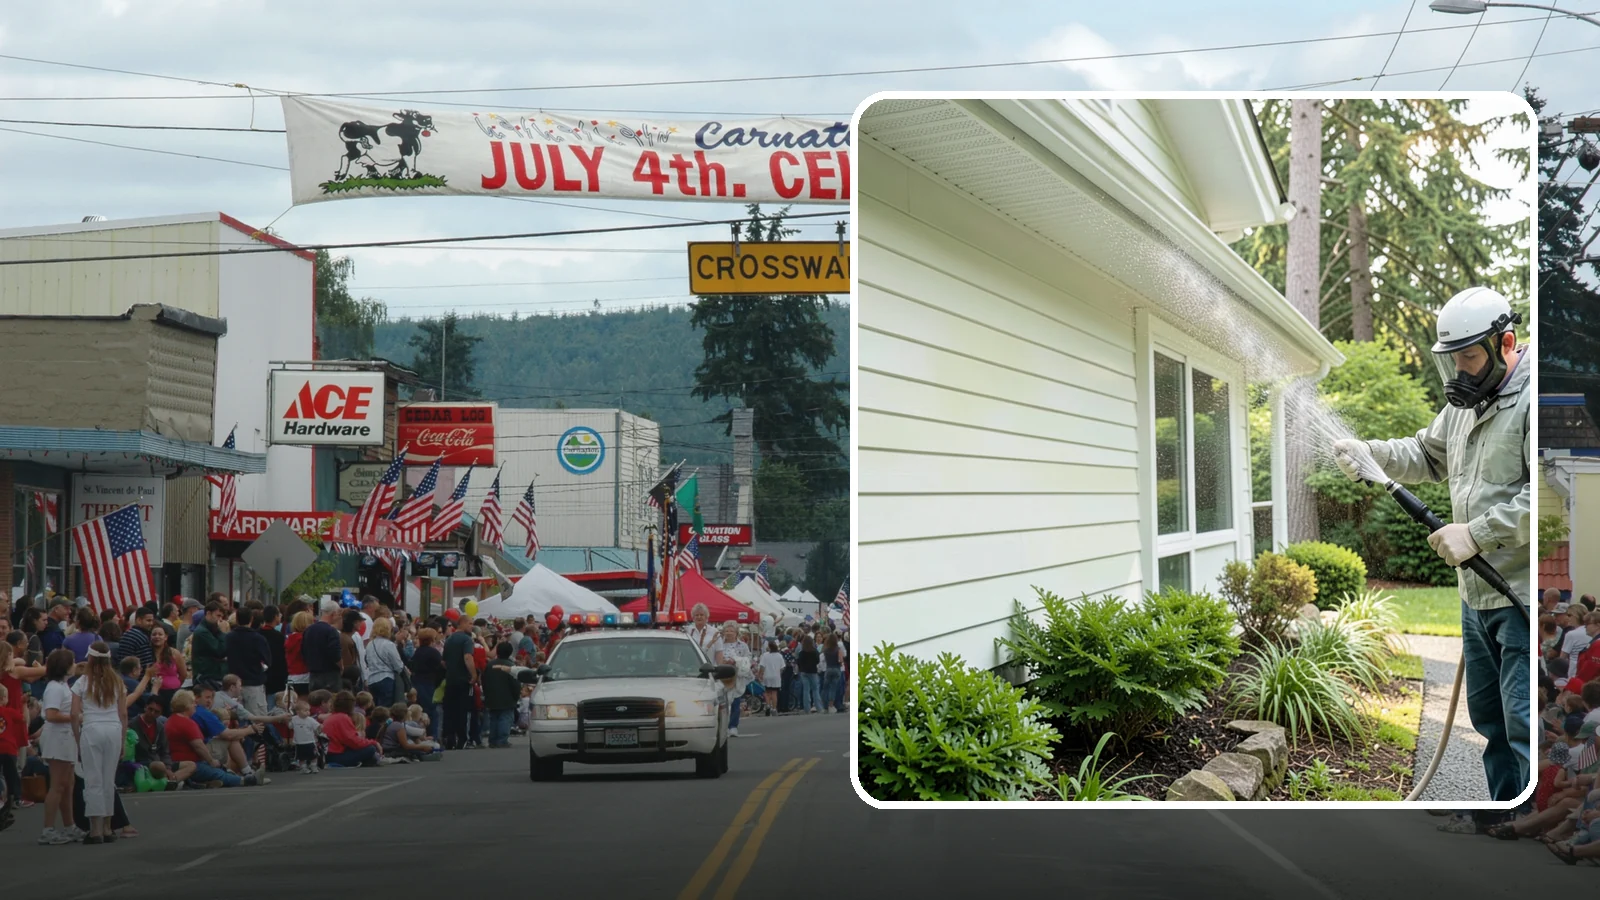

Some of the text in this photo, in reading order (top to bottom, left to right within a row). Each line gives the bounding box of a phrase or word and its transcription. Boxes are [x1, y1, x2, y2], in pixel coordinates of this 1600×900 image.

[481, 141, 605, 192] JULY
[632, 150, 746, 198] 4th.
[697, 254, 850, 280] CROSSWA
[283, 380, 373, 420] ACE
[406, 409, 485, 422] CEDAR LOG
[284, 421, 370, 436] Hardware
[416, 428, 477, 447] Coca-Cola
[354, 467, 387, 480] Simpl
[83, 486, 155, 495] St. Vincent de Paul
[688, 527, 741, 535] CRNATION
[699, 535, 730, 543] GLASS
